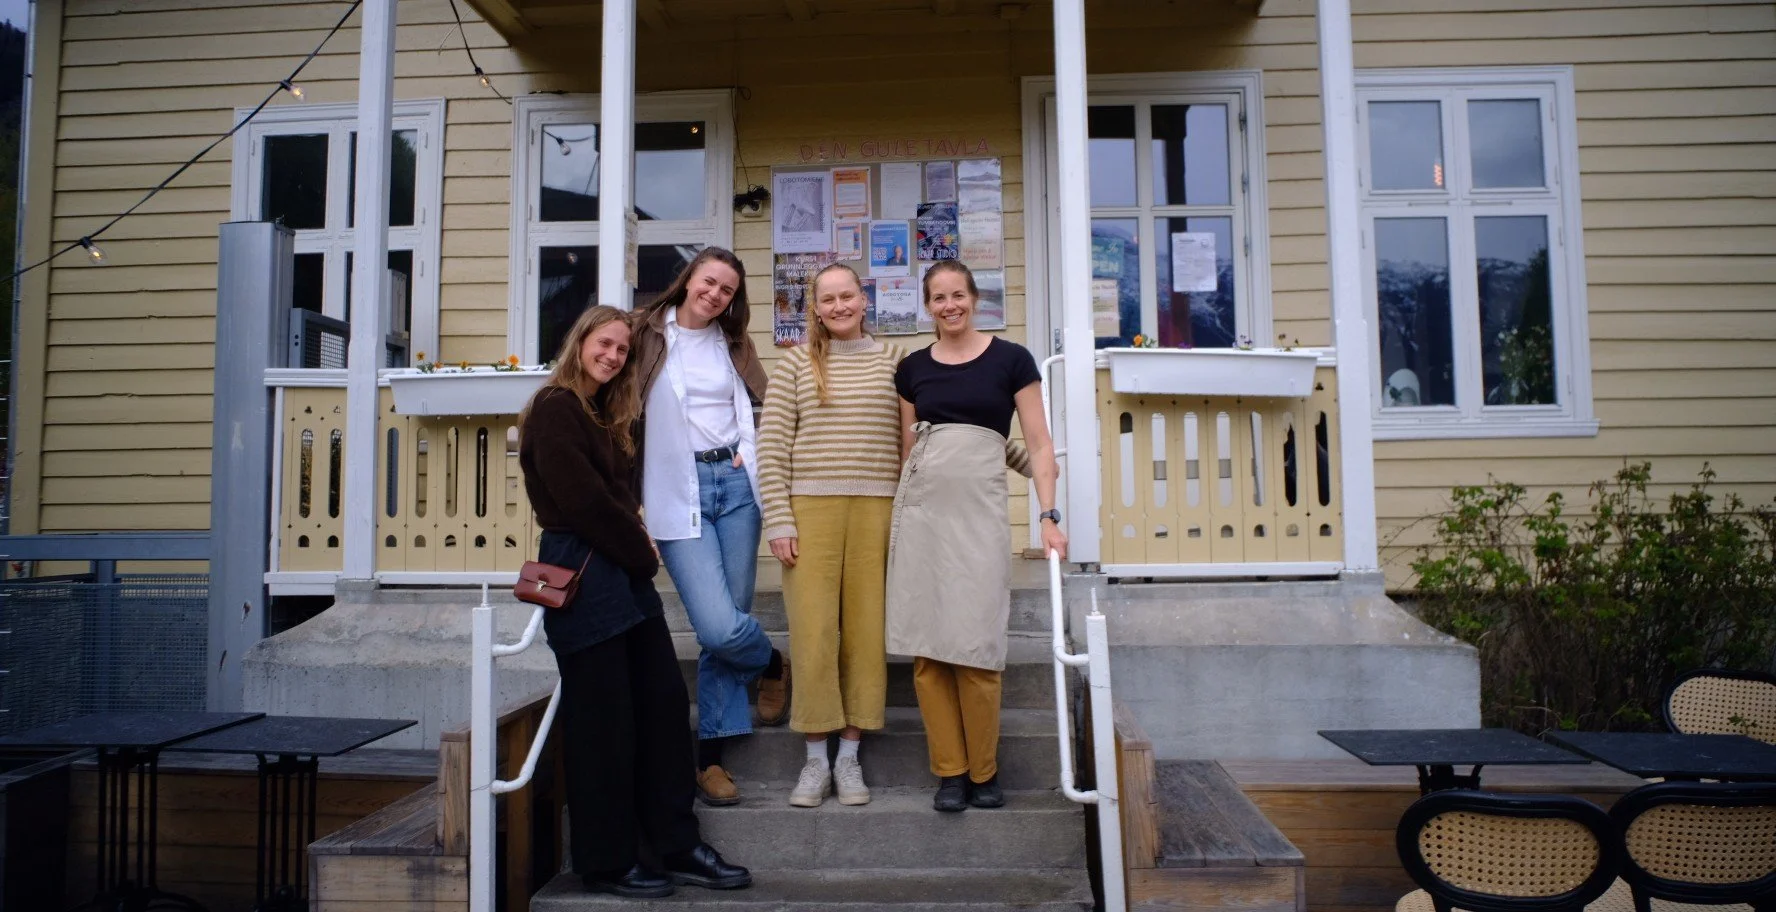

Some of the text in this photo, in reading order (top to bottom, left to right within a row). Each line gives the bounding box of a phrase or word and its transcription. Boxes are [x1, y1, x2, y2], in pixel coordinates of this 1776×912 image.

[800, 136, 989, 161] DEN GULE TAVLA
[776, 328, 800, 341] SKAAR
